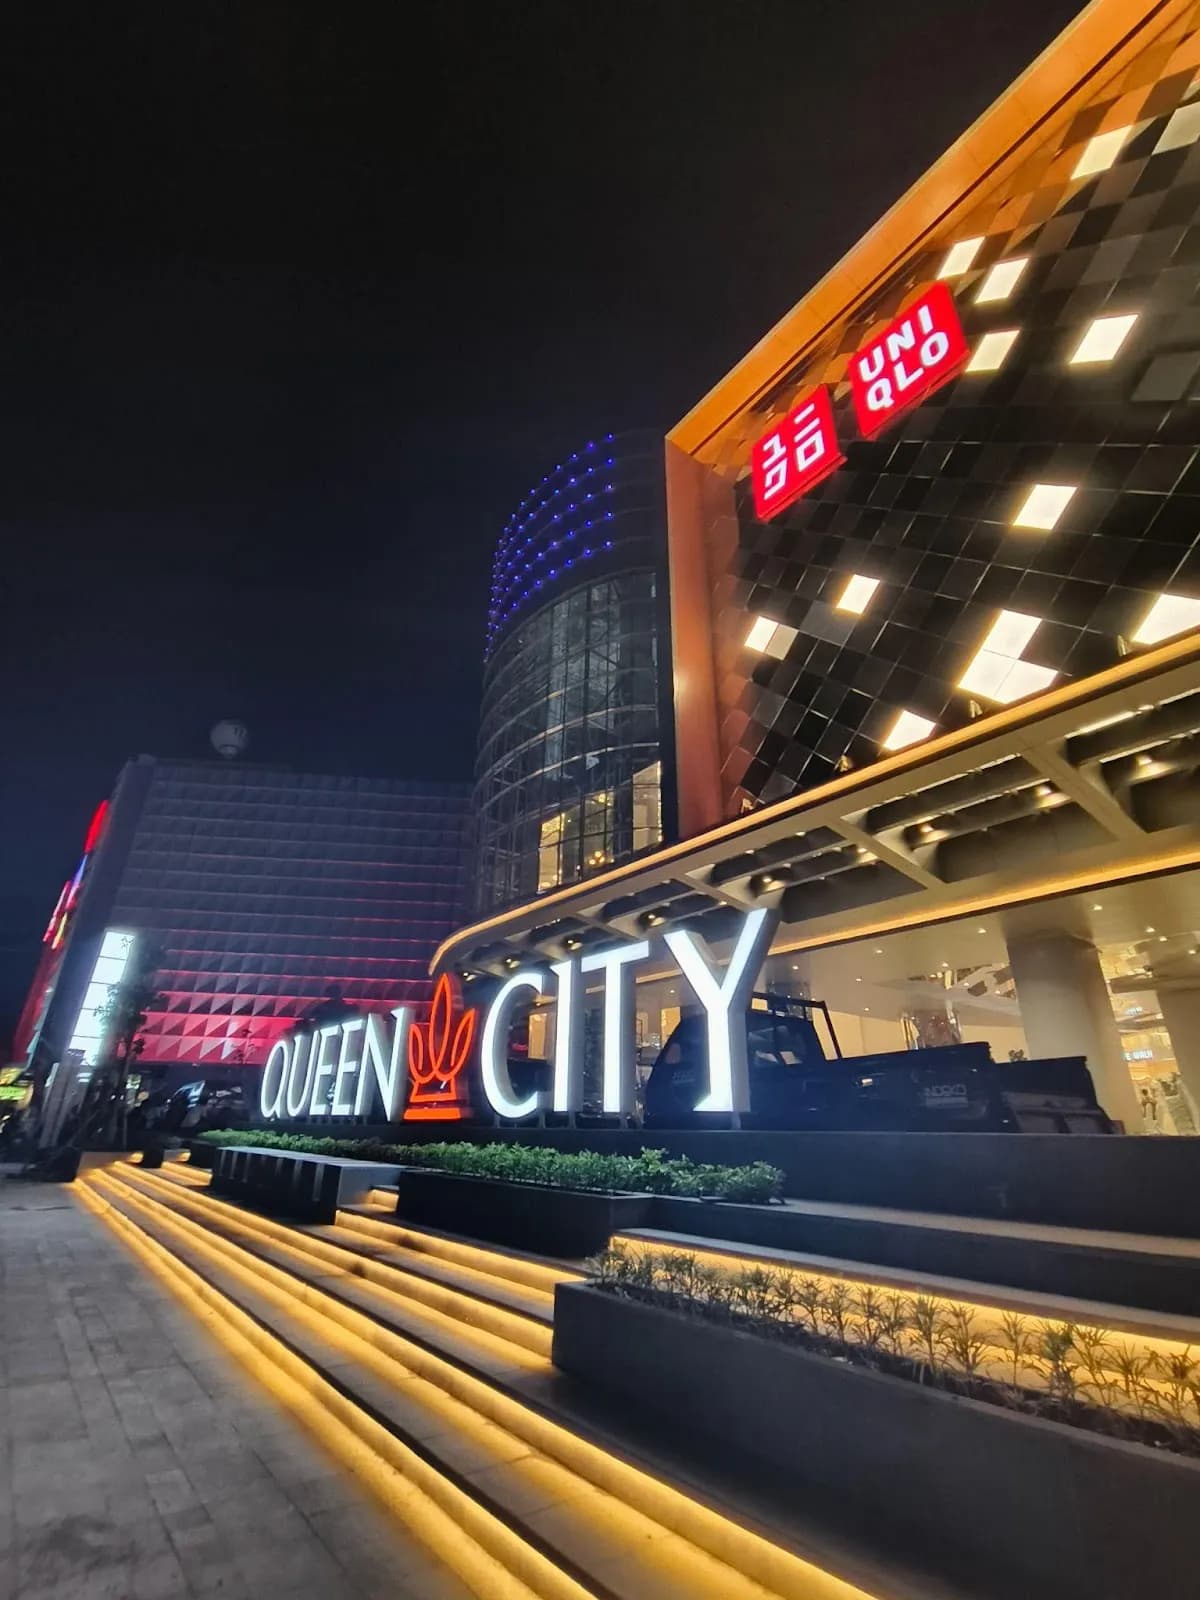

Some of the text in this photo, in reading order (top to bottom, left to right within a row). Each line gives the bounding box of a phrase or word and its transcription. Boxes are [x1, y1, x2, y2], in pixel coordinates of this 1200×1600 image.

[857, 304, 935, 383] UNI
[865, 330, 950, 412] QLO
[259, 907, 769, 1121] QUEEN CITY
